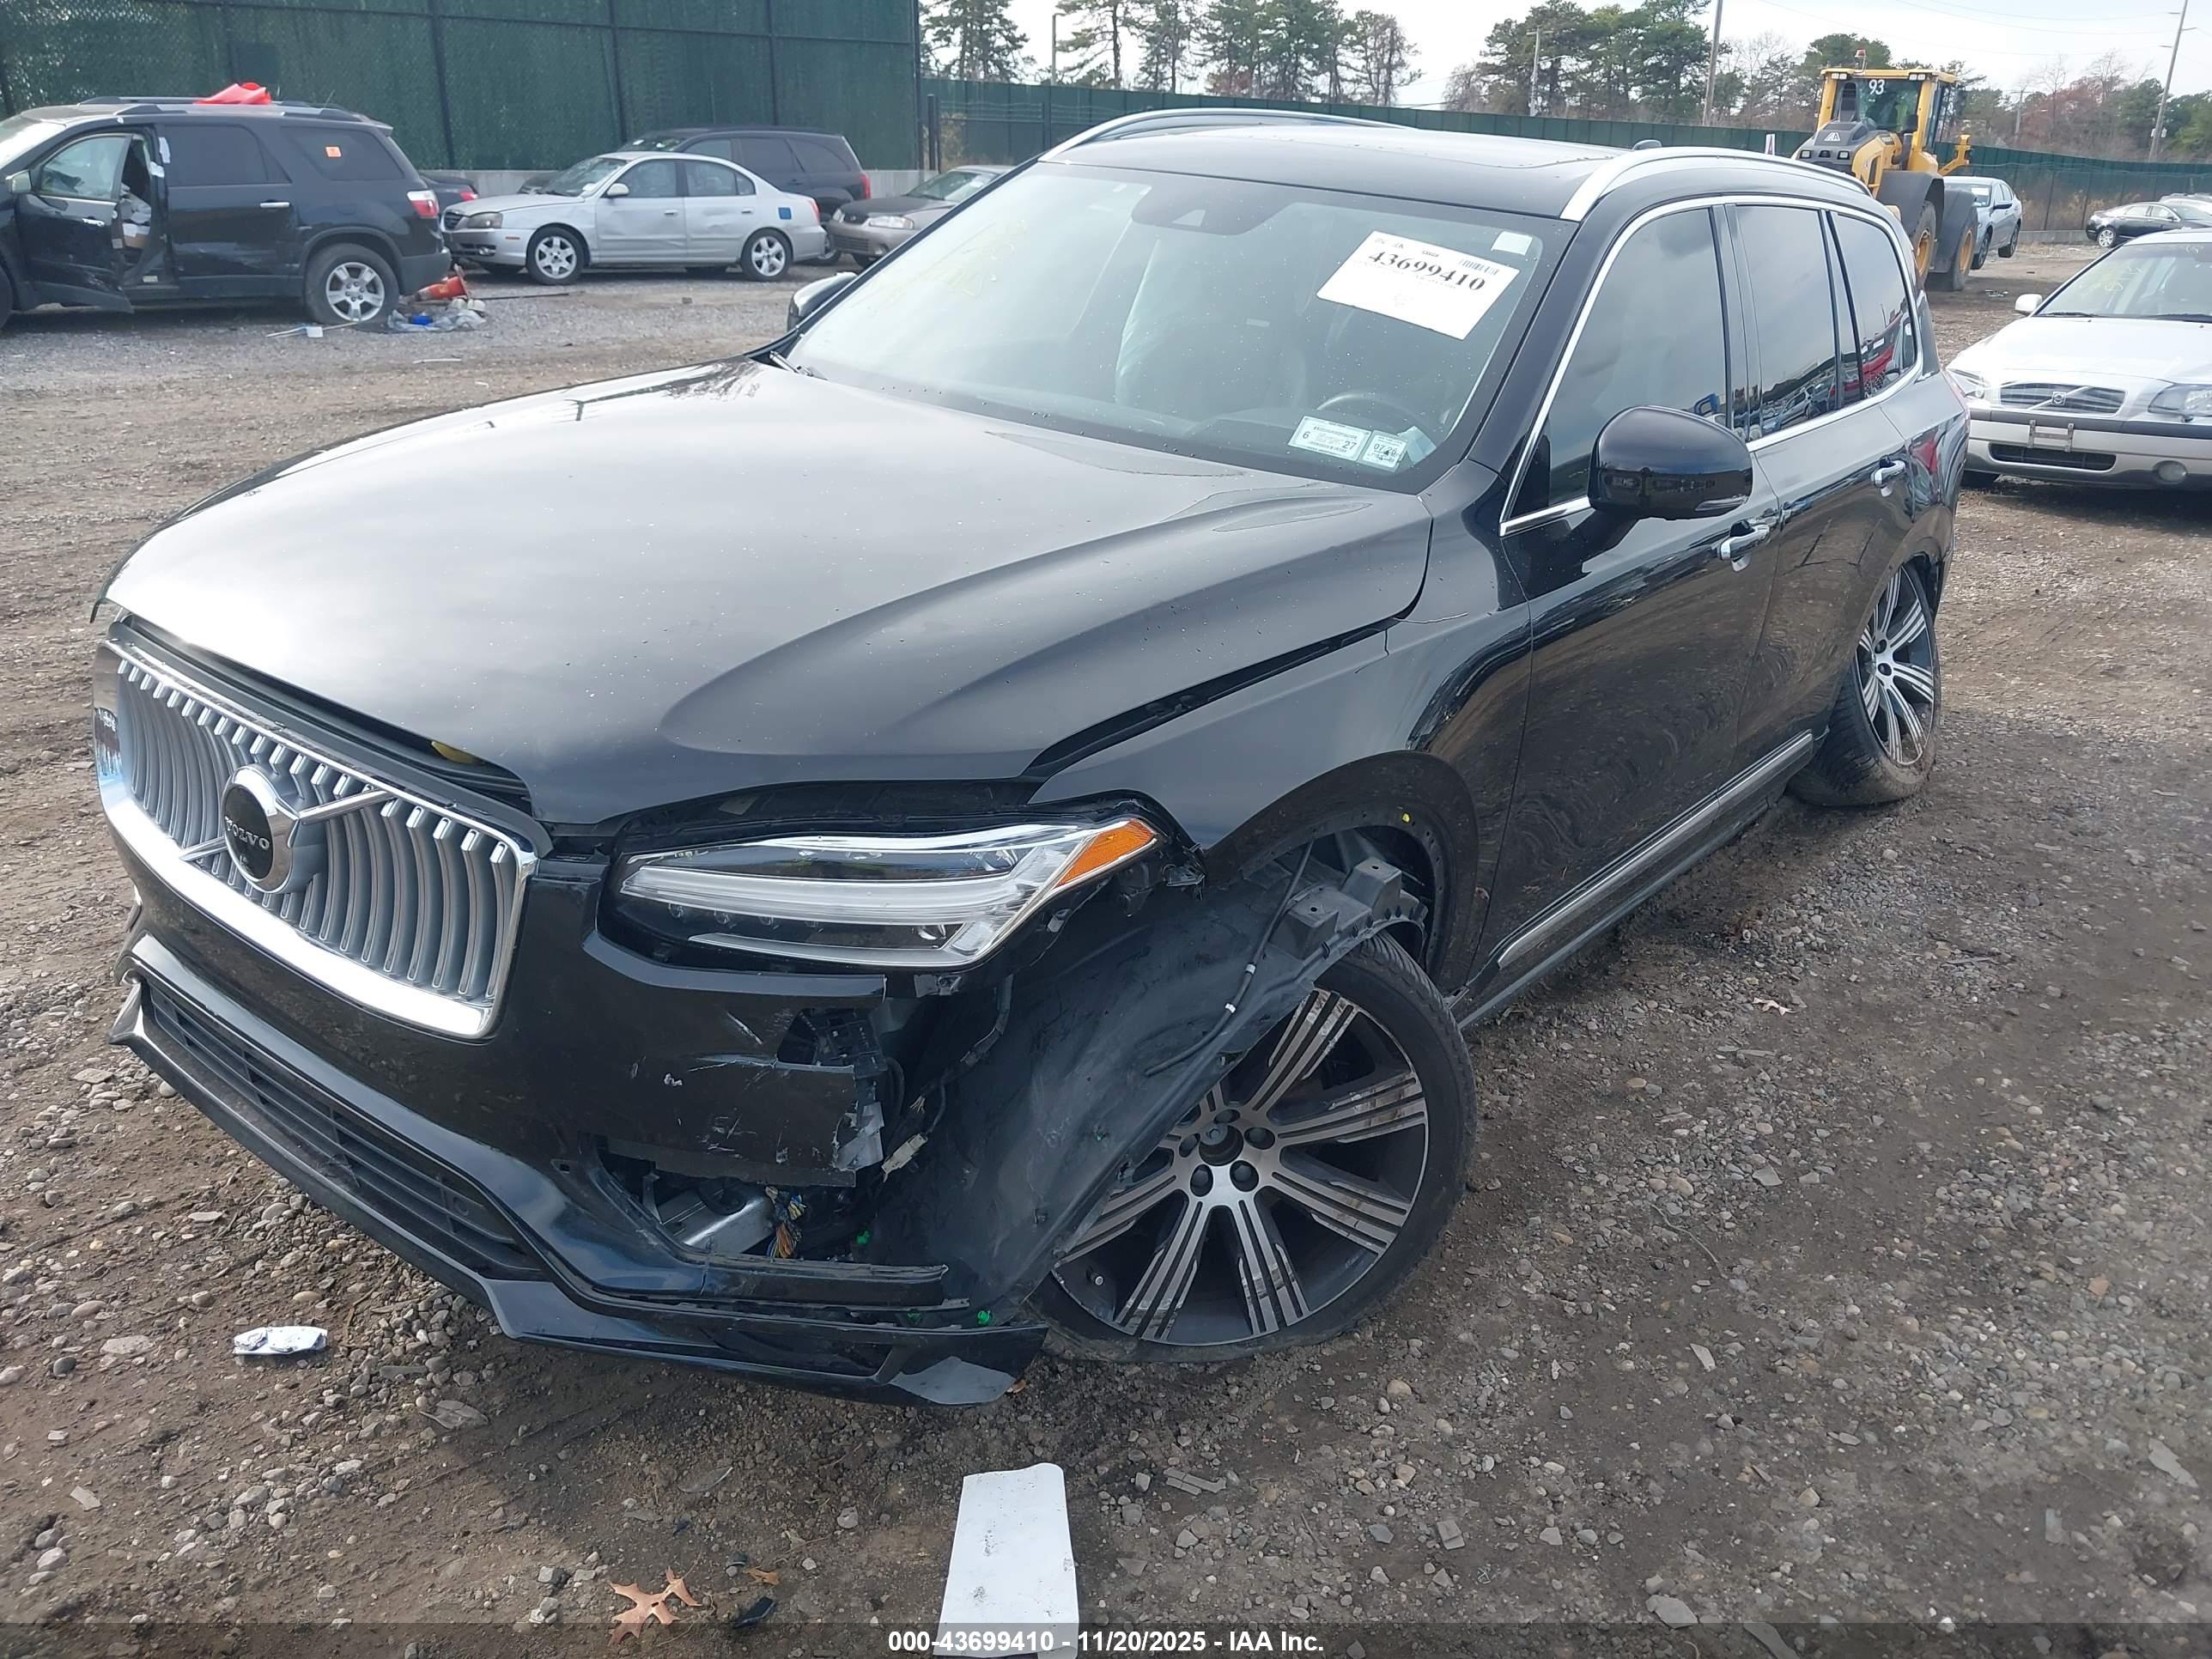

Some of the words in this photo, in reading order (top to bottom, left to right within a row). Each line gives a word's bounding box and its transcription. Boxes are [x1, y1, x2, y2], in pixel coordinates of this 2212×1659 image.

[1869, 79, 1886, 95] 93
[1369, 251, 1486, 290] 43699410
[1342, 441, 1358, 450] 27
[224, 816, 270, 851] VOLVO
